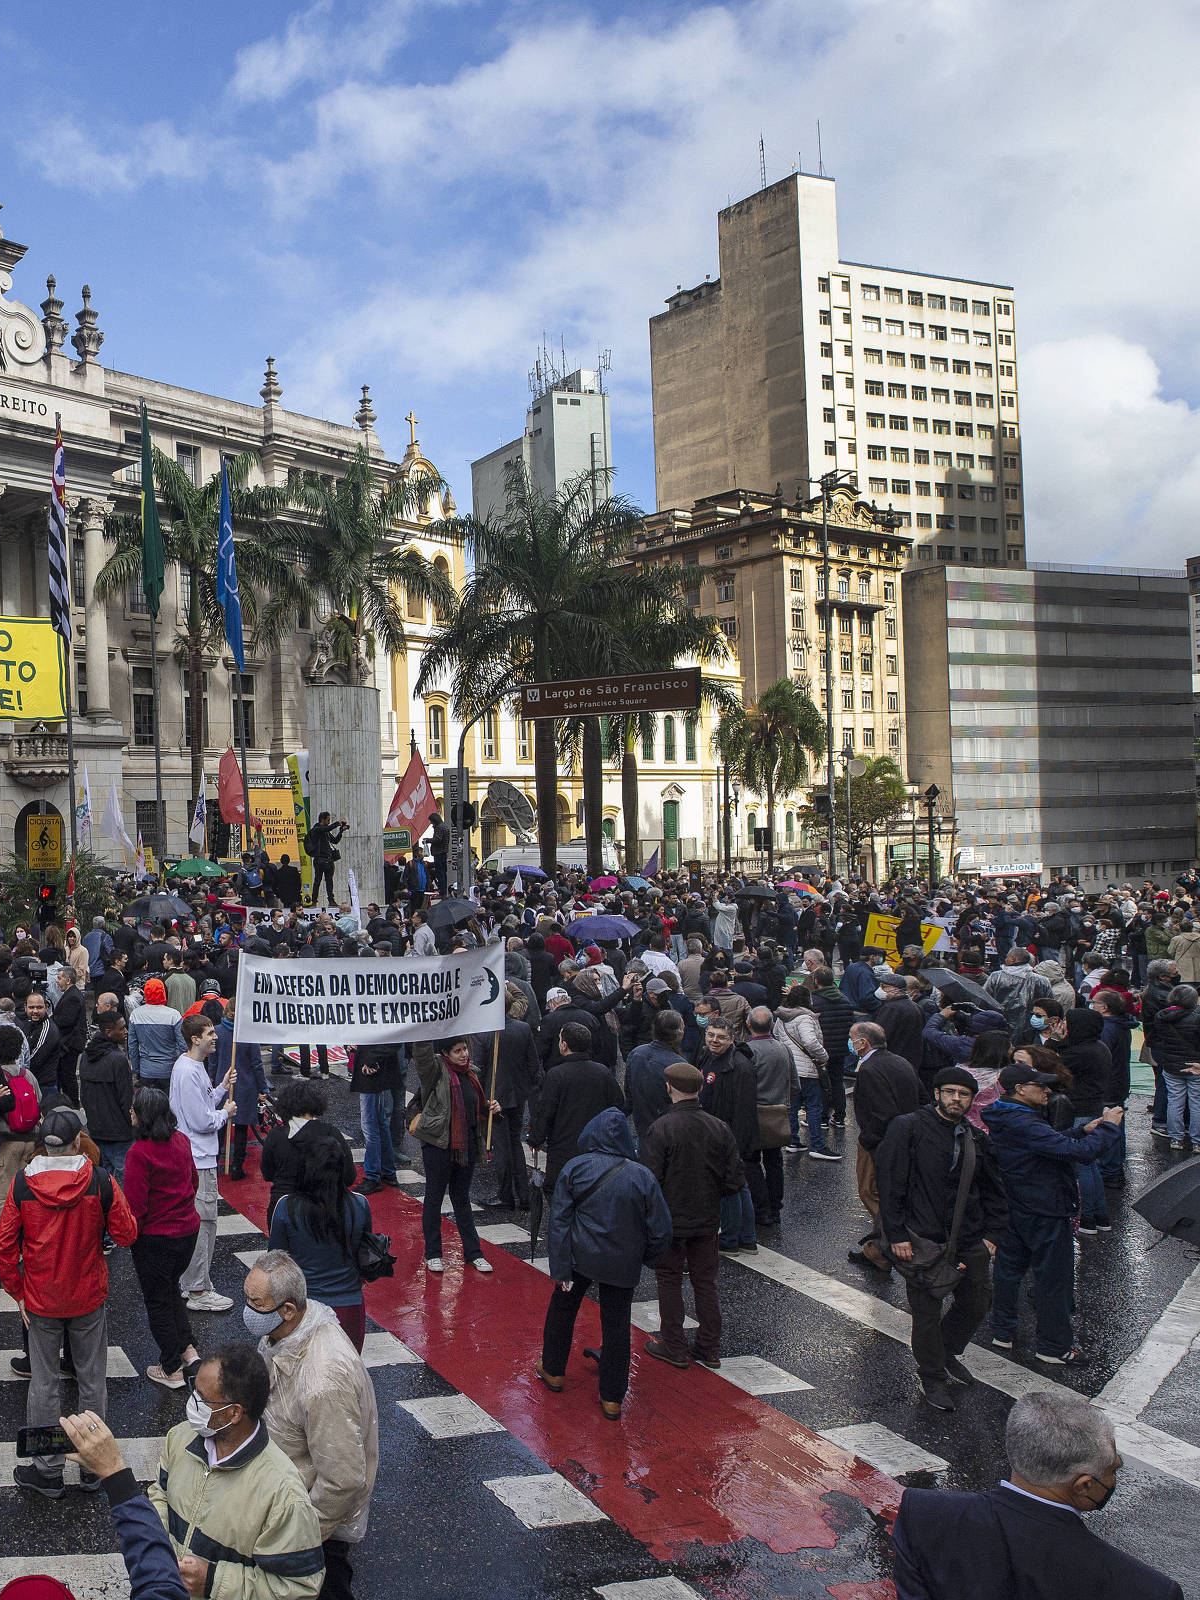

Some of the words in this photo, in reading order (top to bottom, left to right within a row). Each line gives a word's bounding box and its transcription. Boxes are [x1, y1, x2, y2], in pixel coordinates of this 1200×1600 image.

[545, 689, 575, 701] Largo
[579, 687, 592, 696] de
[597, 684, 619, 695] São
[623, 679, 689, 693] Francisco
[579, 699, 617, 709] Francisco
[619, 697, 648, 706] Square
[255, 807, 282, 816] Estado
[266, 827, 294, 836] Direito
[254, 971, 273, 994] EM
[275, 973, 325, 997] DEFESA
[330, 973, 351, 996] DA
[355, 970, 453, 996] DEMOCRACIA
[455, 967, 461, 989] E
[252, 1000, 272, 1024] DA
[276, 1001, 354, 1025] LIBERDADE
[358, 1002, 378, 1025] DE
[382, 994, 460, 1025] EXPRESSÃO
